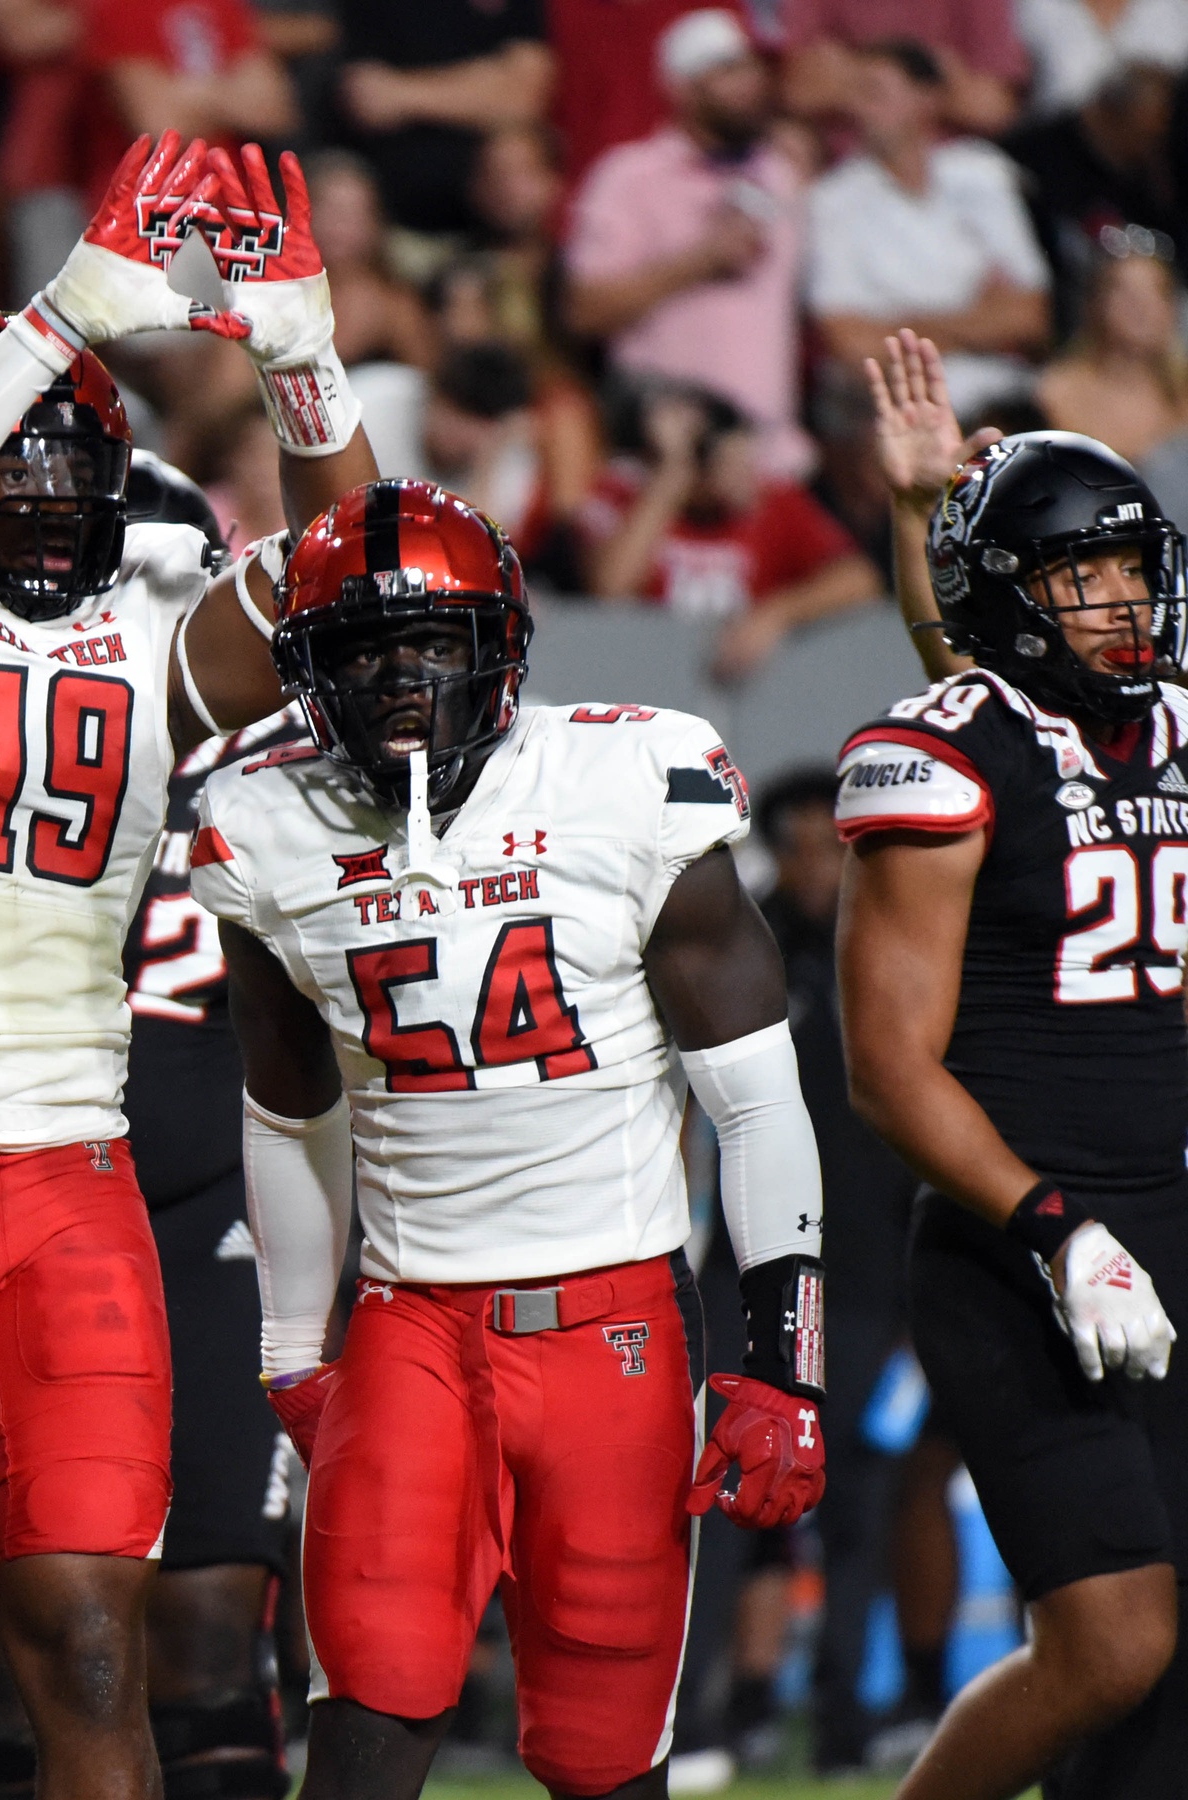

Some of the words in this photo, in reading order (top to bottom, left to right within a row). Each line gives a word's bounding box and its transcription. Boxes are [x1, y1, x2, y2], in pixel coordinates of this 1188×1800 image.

[1117, 502, 1143, 521] HTT
[47, 632, 128, 667] TECH
[1066, 805, 1113, 848] NC
[354, 889, 442, 926] TEA
[458, 868, 540, 909] TECH
[1053, 841, 1186, 1004] 29
[345, 916, 598, 1093] 54
